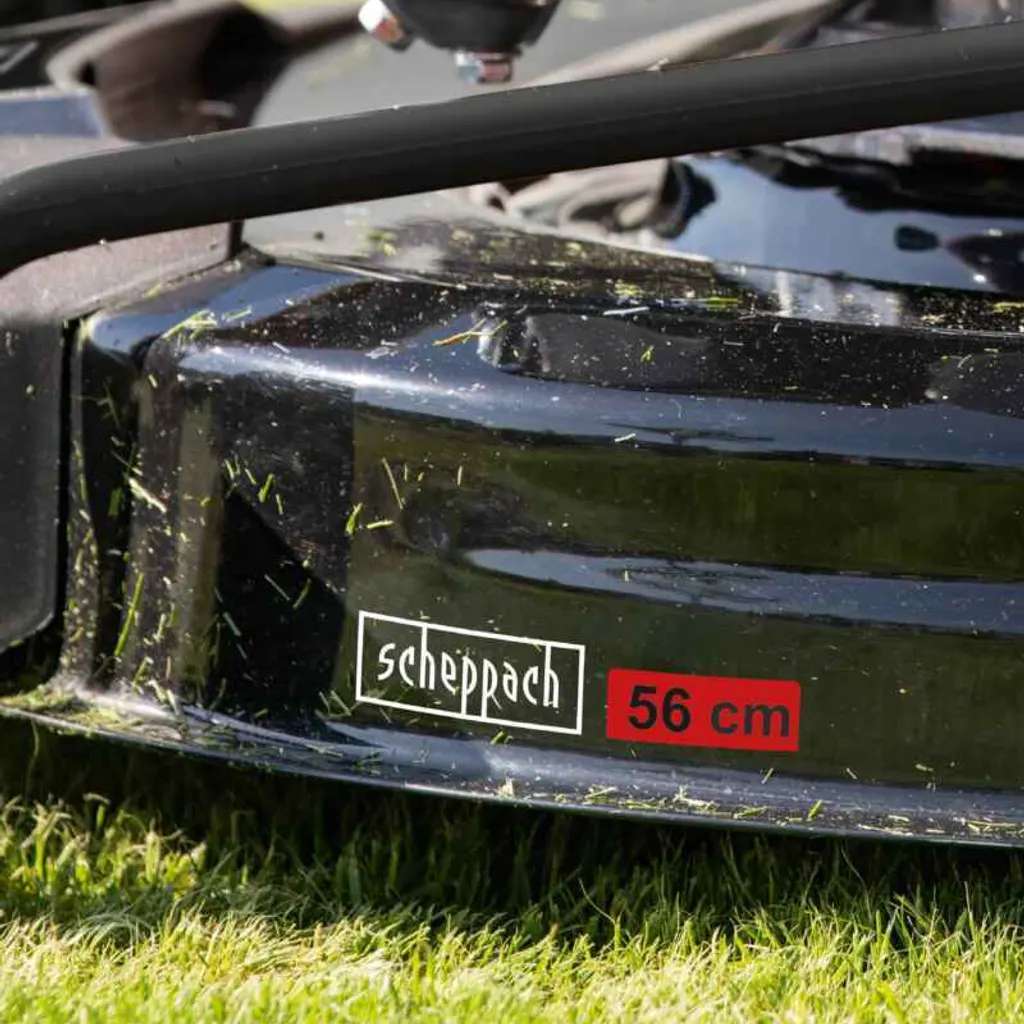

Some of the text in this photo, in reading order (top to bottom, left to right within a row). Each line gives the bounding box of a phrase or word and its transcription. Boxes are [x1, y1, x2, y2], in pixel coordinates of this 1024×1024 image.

[376, 626, 559, 717] scheppach
[628, 685, 790, 738] 56 cm
